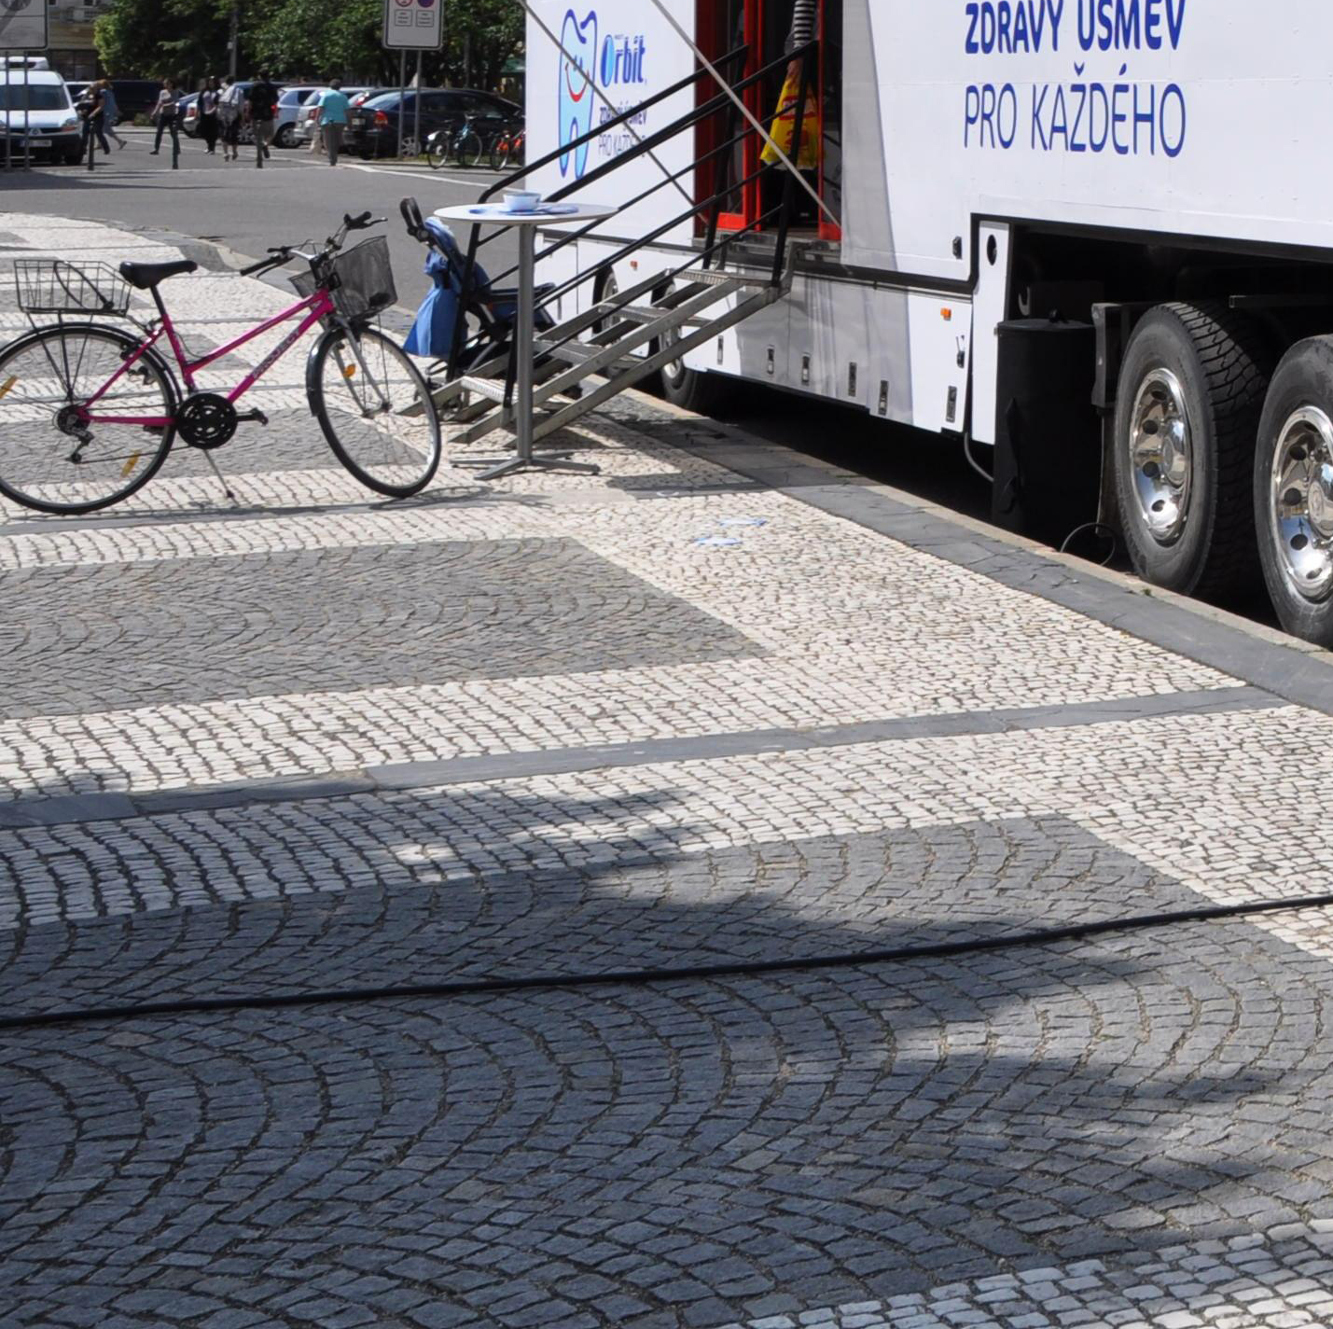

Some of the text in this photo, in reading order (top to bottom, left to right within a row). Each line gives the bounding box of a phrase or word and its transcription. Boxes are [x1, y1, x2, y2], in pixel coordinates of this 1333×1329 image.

[600, 34, 645, 88] Orbit
[964, 61, 1186, 158] PRO KAŽDÉHO
